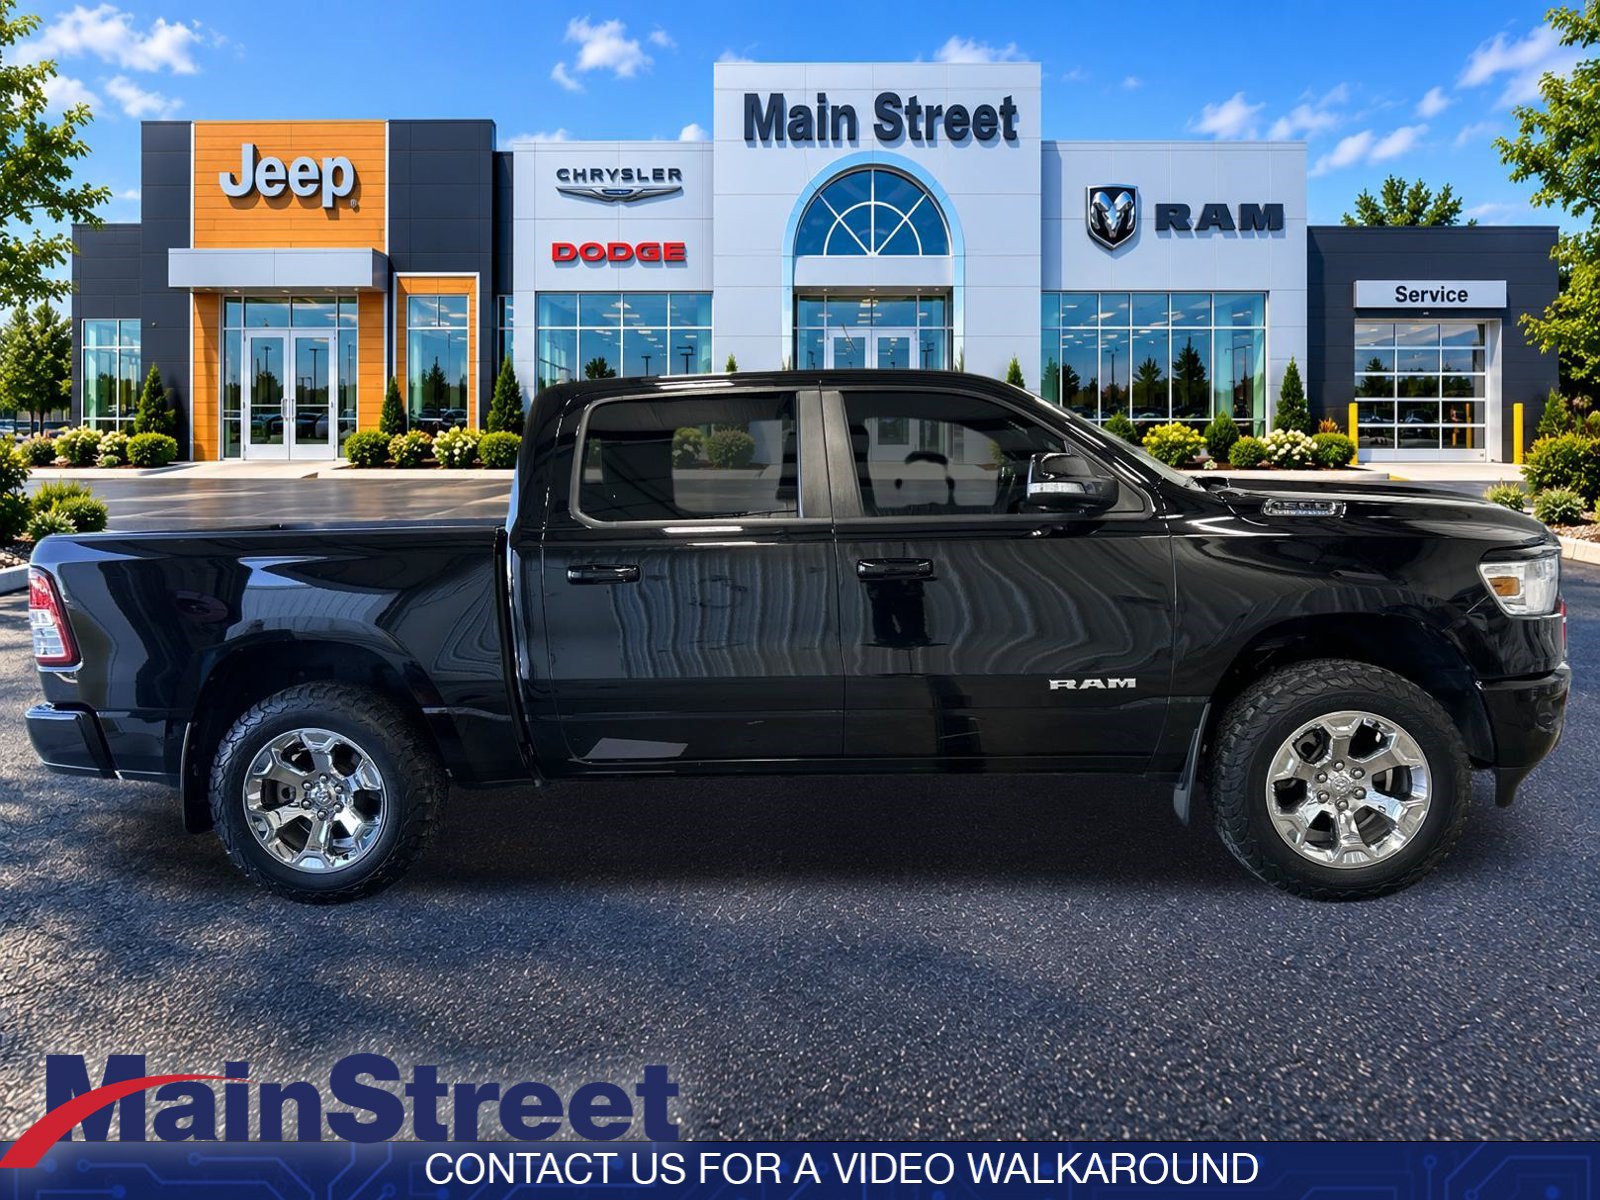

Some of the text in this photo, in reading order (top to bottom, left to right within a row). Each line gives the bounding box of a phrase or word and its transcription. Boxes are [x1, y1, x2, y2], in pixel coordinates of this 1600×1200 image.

[744, 91, 1018, 142] Main Street
[218, 143, 355, 208] Jeep
[556, 167, 683, 182] CHRYSLER
[1155, 203, 1284, 232] RAM
[551, 242, 686, 262] DODGE
[1395, 285, 1469, 303] Service
[1049, 678, 1137, 690] RAM
